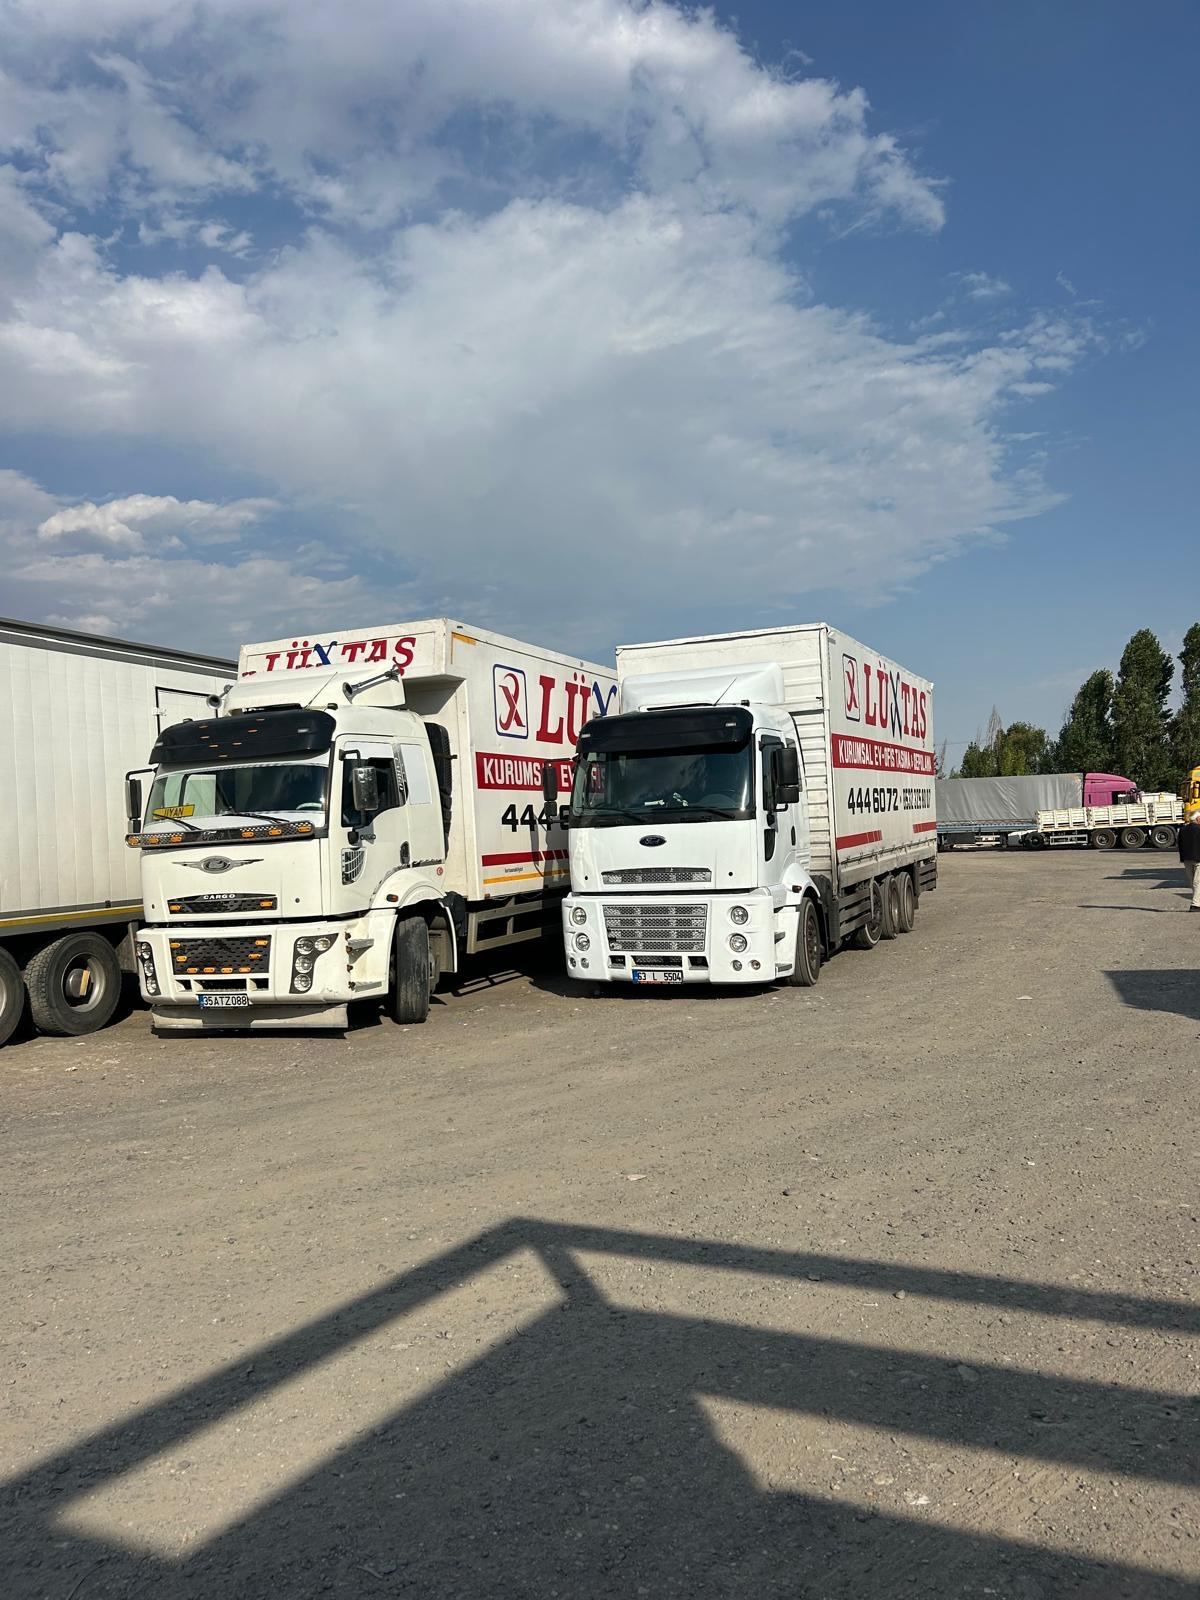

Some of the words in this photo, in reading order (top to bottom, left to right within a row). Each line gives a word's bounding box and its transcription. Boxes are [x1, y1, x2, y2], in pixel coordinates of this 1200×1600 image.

[838, 739, 874, 766] KURUMSAL
[483, 757, 543, 787] KURUMS
[652, 972, 658, 981] L
[664, 972, 682, 982] 5504
[203, 995, 248, 1006] 35ATZ088
